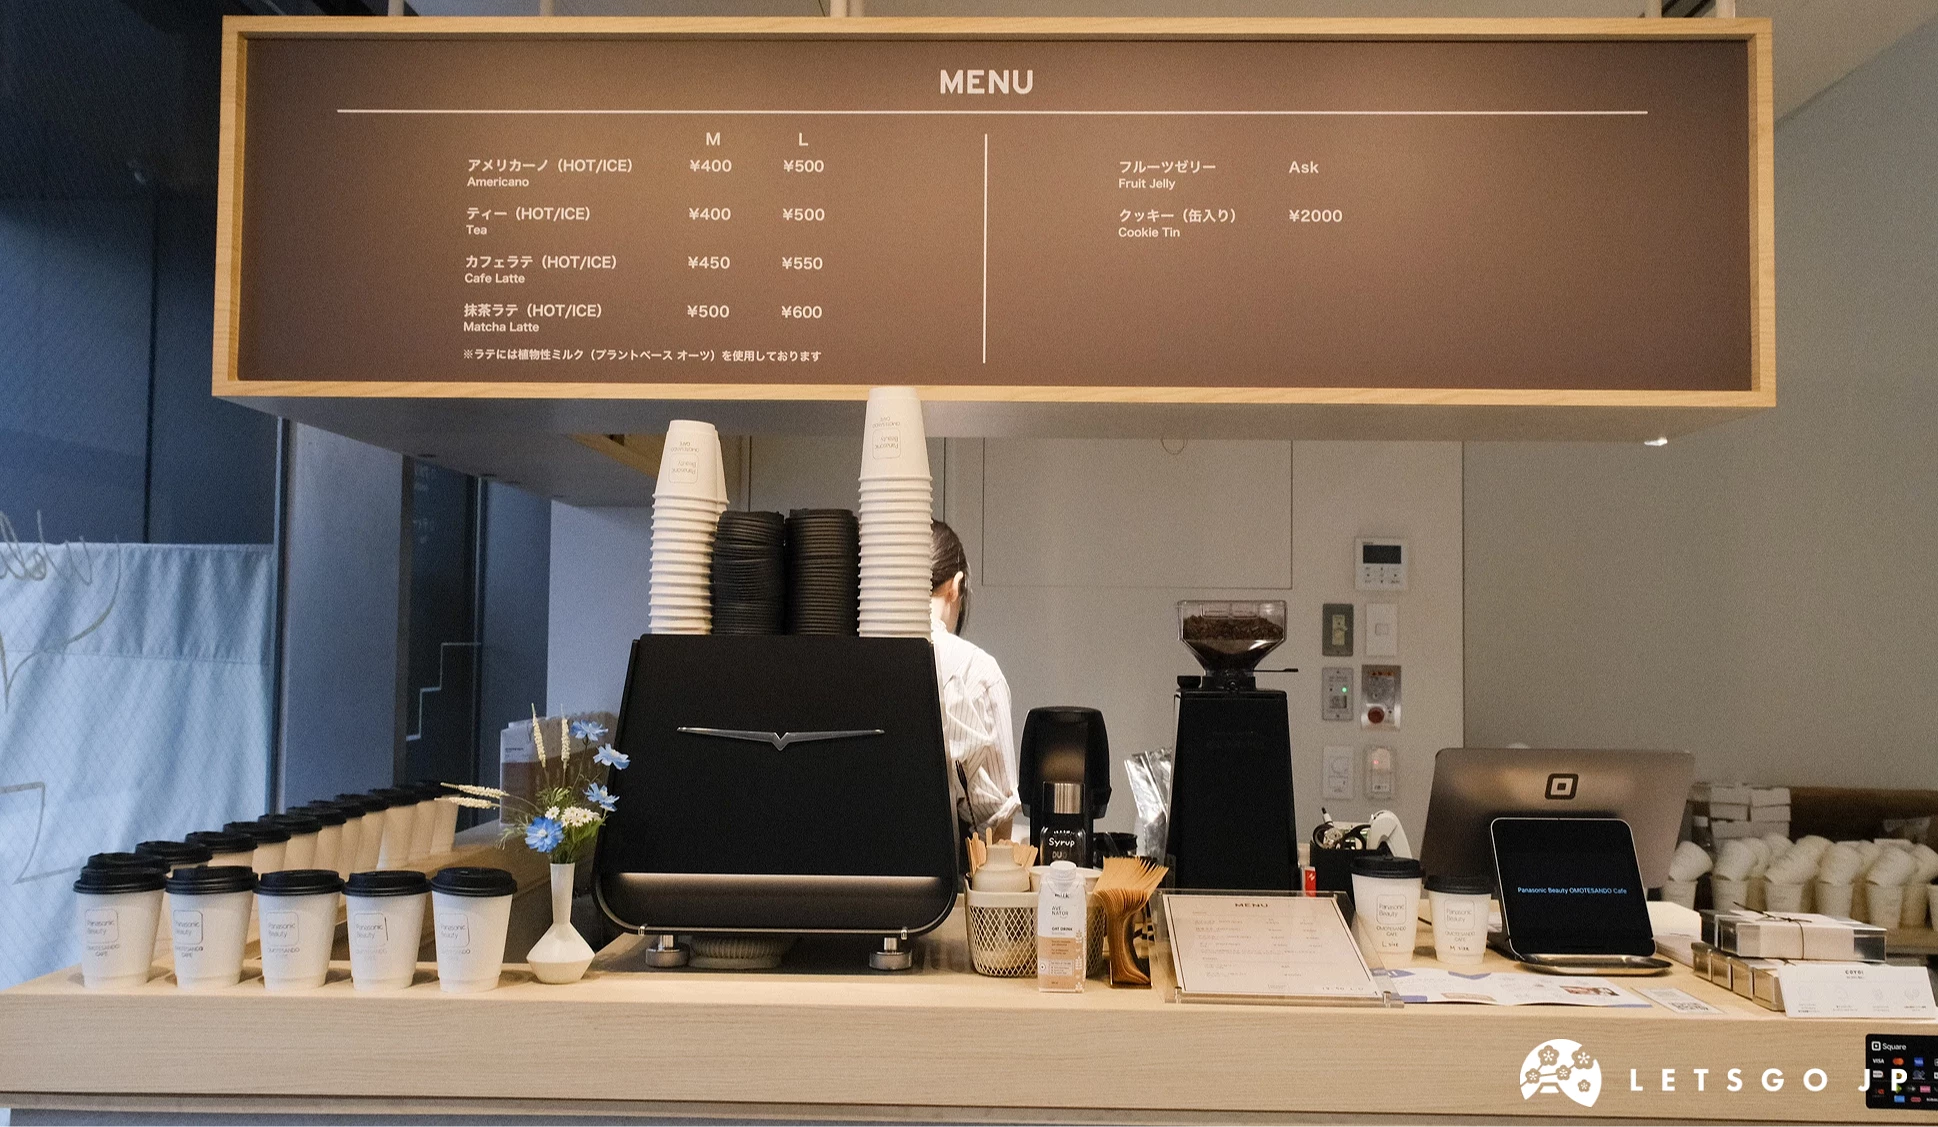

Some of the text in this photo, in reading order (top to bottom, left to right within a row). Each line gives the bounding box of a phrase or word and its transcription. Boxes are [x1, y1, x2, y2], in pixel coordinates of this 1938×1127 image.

[940, 69, 1034, 95] MENU
[705, 132, 809, 147] M L
[690, 159, 732, 173] ¥400
[783, 159, 825, 173] ¥500
[1119, 160, 1319, 174] フルーツゼリー Ask
[467, 176, 530, 187] Americano
[1118, 178, 1176, 191] Fruit Jelly
[689, 207, 732, 221] ¥400
[782, 208, 825, 221] ¥500
[1289, 209, 1343, 223] ¥2000
[466, 224, 488, 235] Tea
[1118, 226, 1181, 238] Cookie Tin
[688, 256, 731, 270] ¥450
[782, 256, 823, 270] ¥550
[464, 272, 526, 284] Cafe Latte
[687, 304, 730, 318] ¥500
[781, 305, 823, 319] ¥600
[463, 321, 540, 333] Matcha Latte
[1048, 837, 1075, 848] Syrup
[1517, 886, 1547, 894] Panasonic
[1547, 887, 1568, 895] Beauty
[1882, 1042, 1907, 1052] Square
